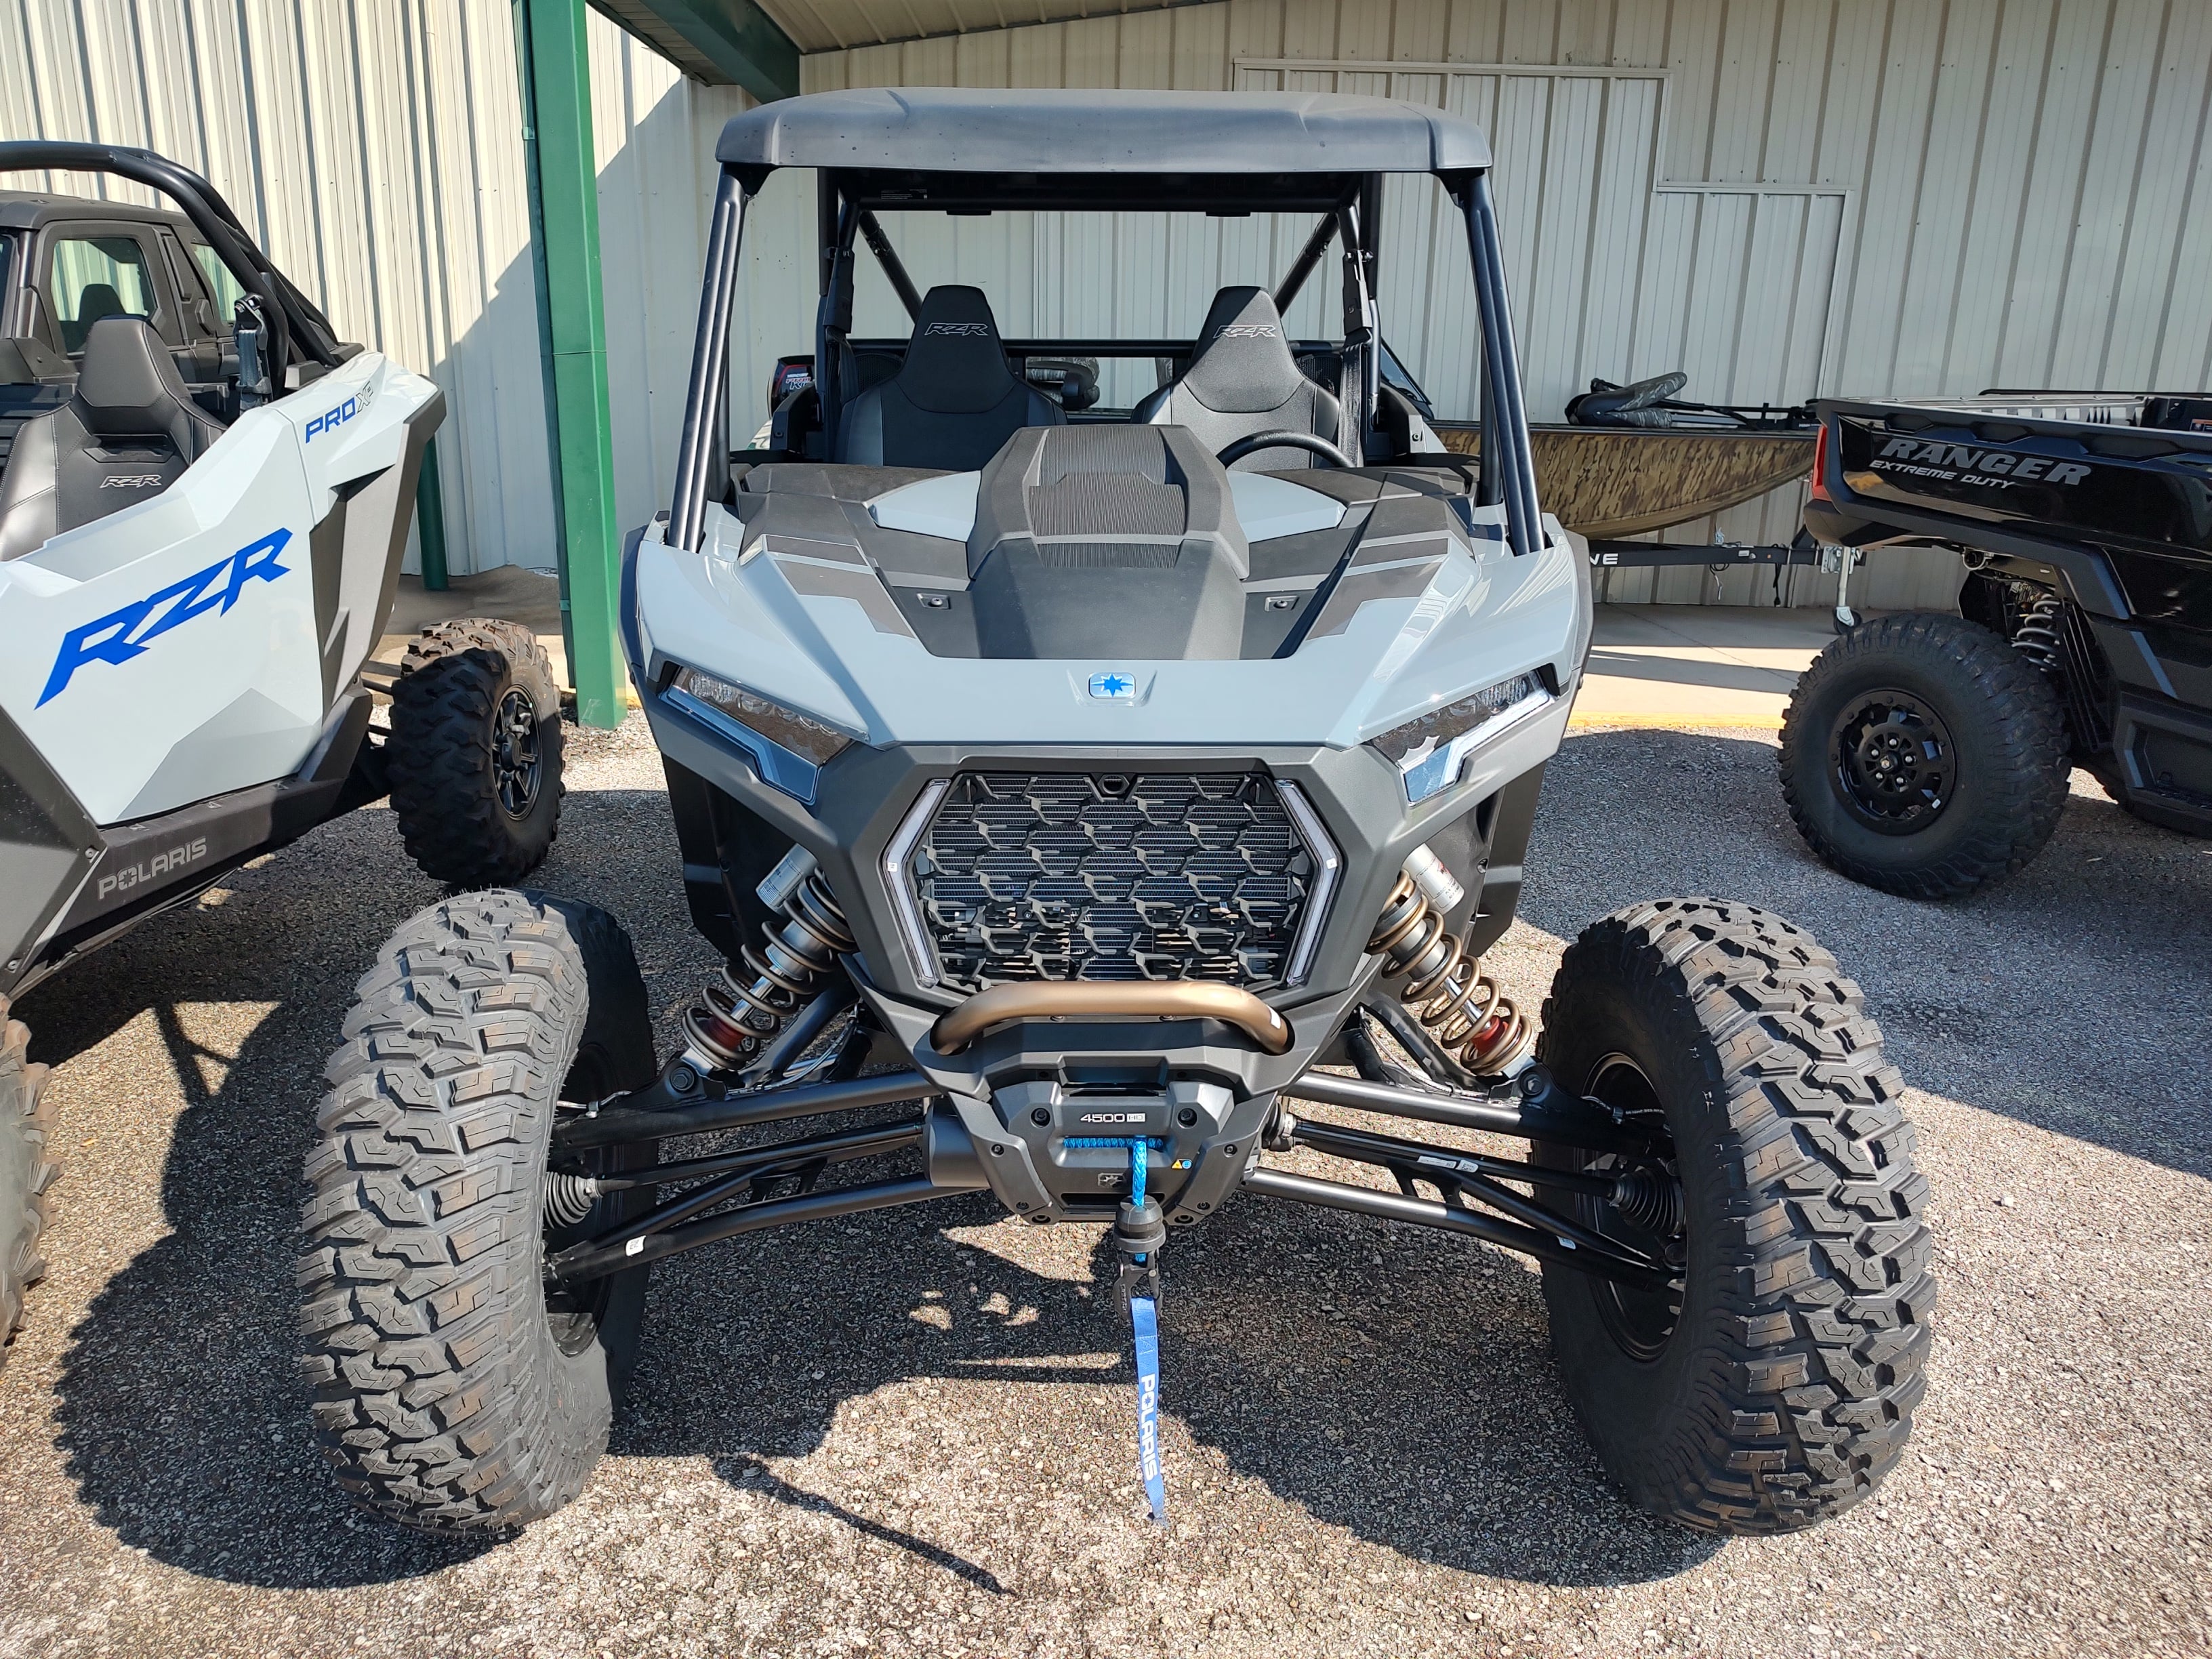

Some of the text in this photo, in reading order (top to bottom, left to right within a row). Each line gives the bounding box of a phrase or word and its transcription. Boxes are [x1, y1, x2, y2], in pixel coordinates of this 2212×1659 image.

[924, 323, 988, 336] RZR
[1212, 325, 1276, 338] RZR
[1869, 459, 2016, 489] EXTREME DUTY
[1879, 438, 2091, 485] RANGER
[100, 474, 162, 488] RZR
[34, 527, 293, 710] RZR
[98, 836, 207, 901] POLARIS
[1080, 1113, 1145, 1122] 4500 HD
[1141, 1373, 1158, 1481] POLARIS
